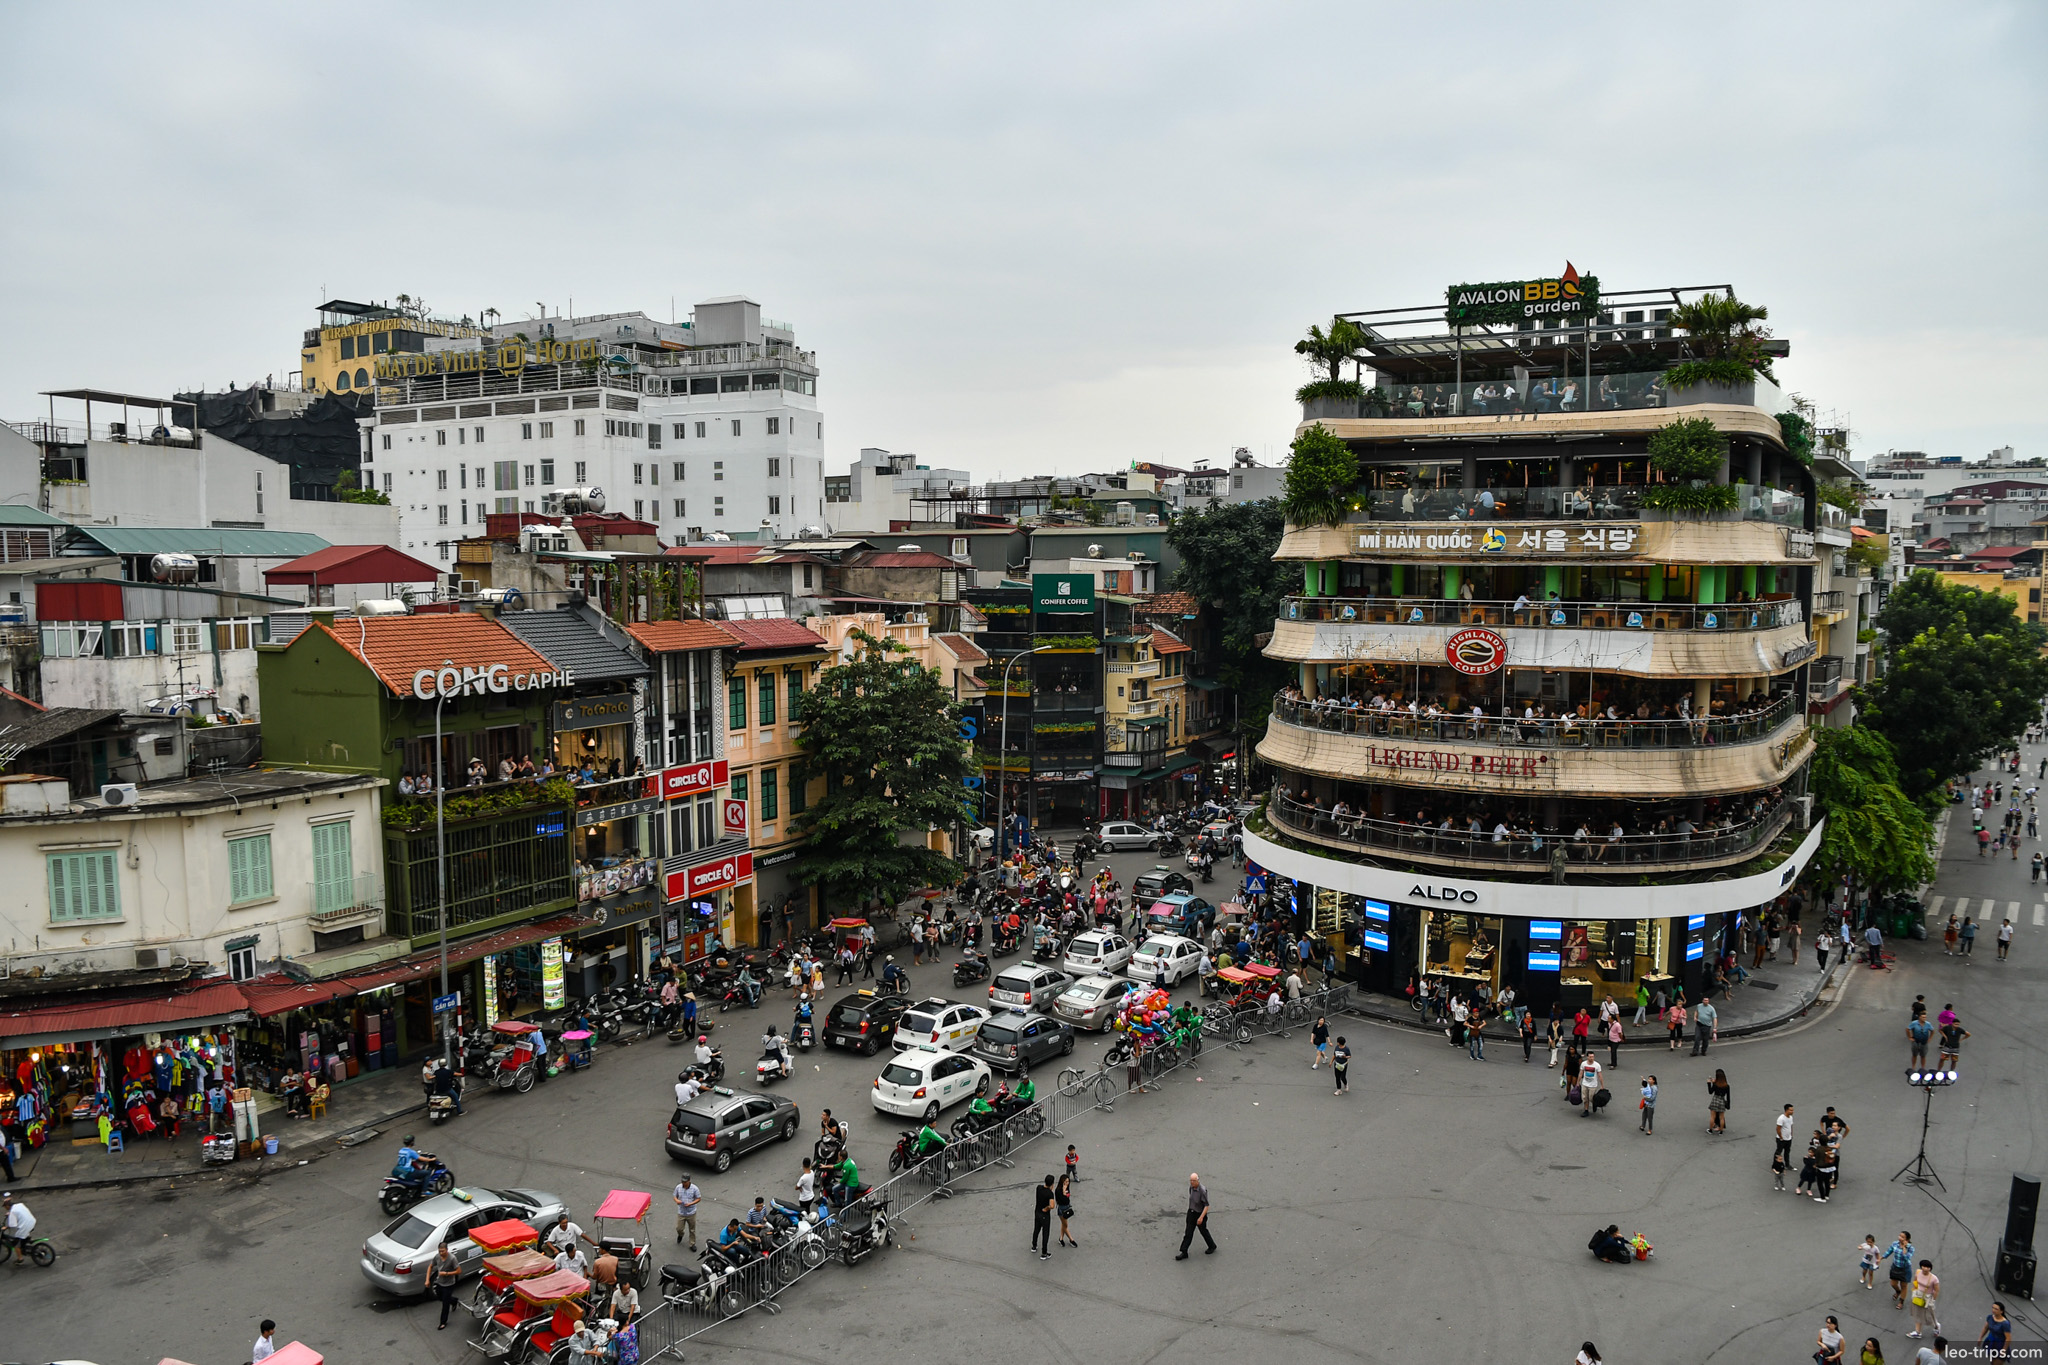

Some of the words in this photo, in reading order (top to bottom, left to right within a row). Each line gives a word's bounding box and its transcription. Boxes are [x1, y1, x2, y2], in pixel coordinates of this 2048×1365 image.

[1457, 288, 1521, 306] AVALON
[1524, 279, 1585, 301] BBQ
[1524, 301, 1581, 317] garden
[400, 317, 450, 337] SKYLINE
[374, 355, 411, 378] MAY
[535, 338, 600, 364] HOTEL
[1359, 531, 1381, 548] MÌ
[1385, 531, 1420, 549] HÀN
[1426, 529, 1472, 549] QUỐC
[1516, 530, 1569, 551] 서울
[1577, 529, 1636, 551] 식당
[1449, 631, 1503, 651] HIGHLANDS
[1455, 661, 1497, 673] COFFEE
[412, 659, 509, 700] CÔNG
[1370, 747, 1460, 771] LEGEND
[1471, 755, 1537, 777] BEER
[669, 773, 697, 788] CIRCLE
[700, 769, 709, 785] K
[728, 805, 743, 824] K
[763, 851, 797, 866] Vietcombank
[694, 869, 721, 886] CIRCLE
[724, 864, 734, 880] K
[1408, 884, 1479, 904] ALDO
